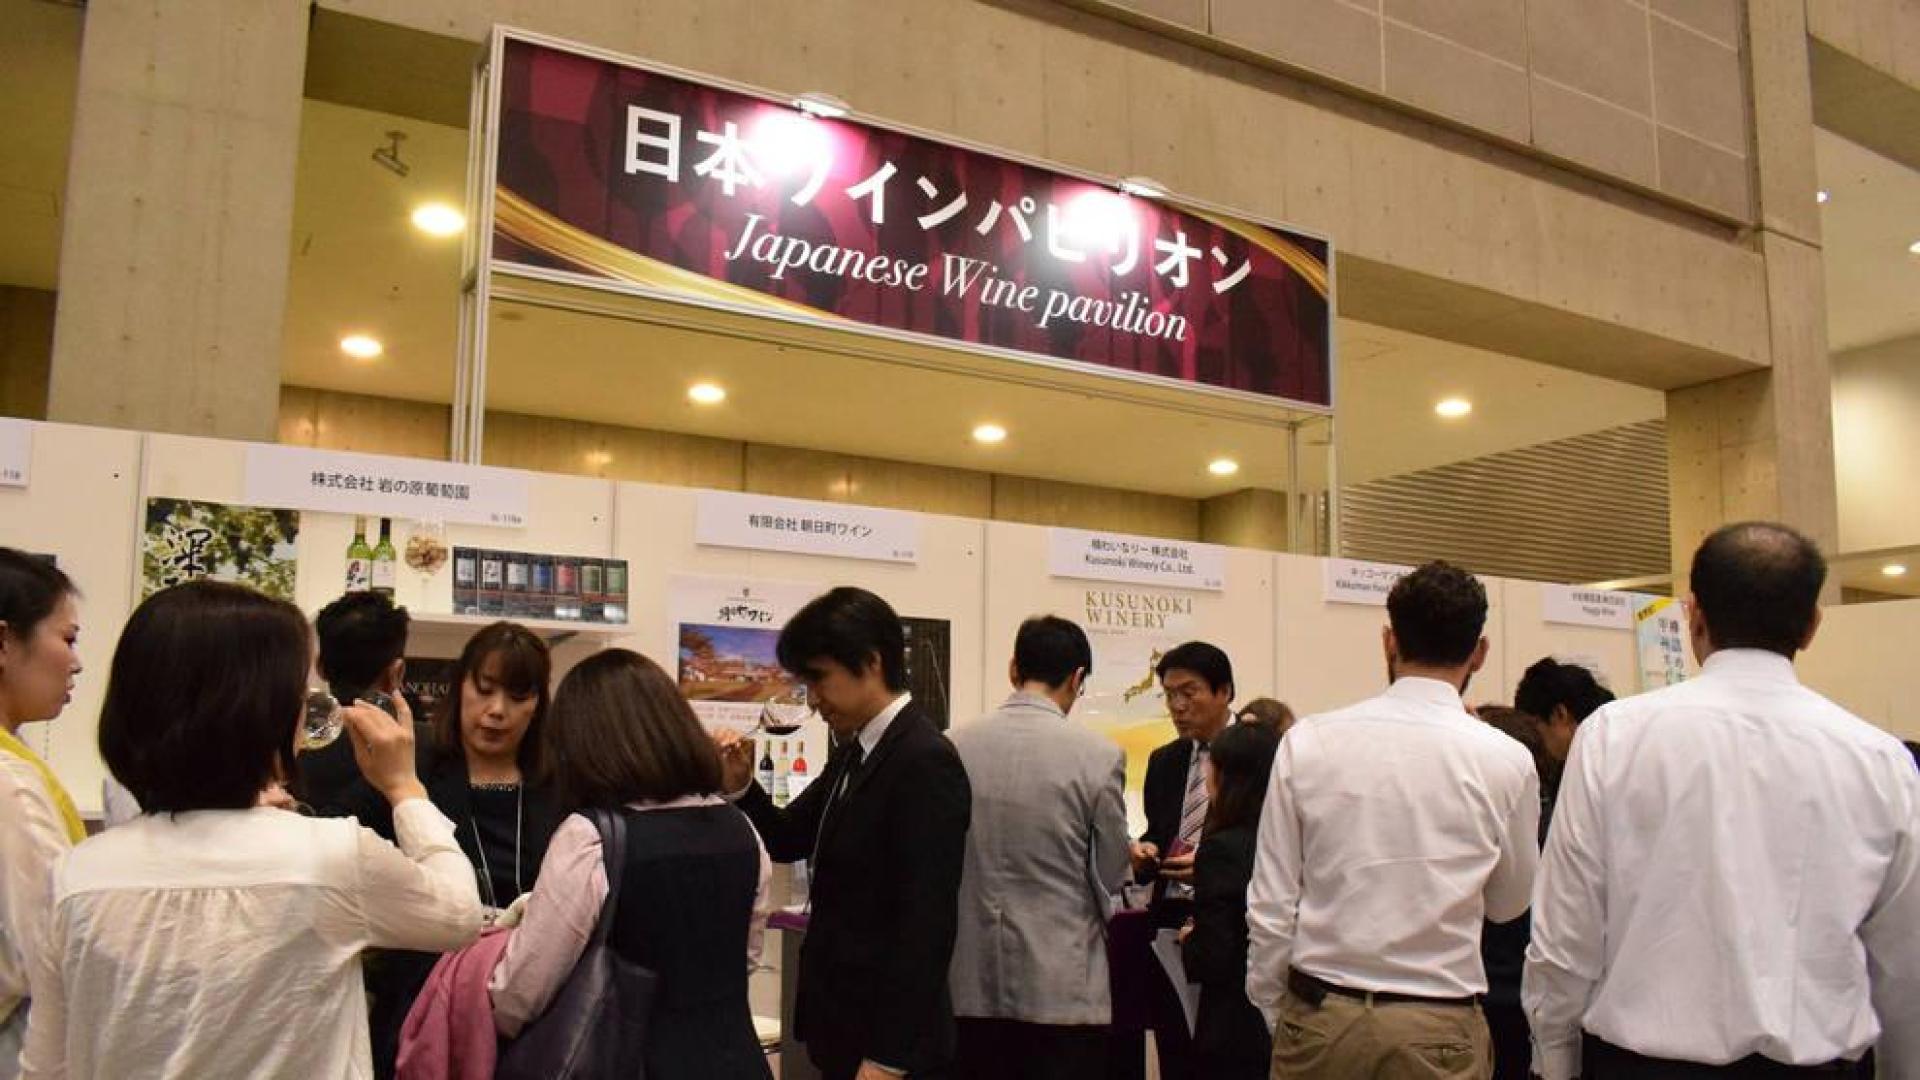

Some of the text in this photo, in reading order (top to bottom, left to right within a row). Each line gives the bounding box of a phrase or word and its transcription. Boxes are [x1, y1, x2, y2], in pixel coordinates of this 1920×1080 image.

[724, 213, 1187, 341] Japanese Wine pavilion
[311, 471, 374, 492] 株式会社
[749, 514, 798, 532] 有限会社
[1086, 590, 1192, 615] KUSUNOKI
[1086, 608, 1169, 629] WINERY
